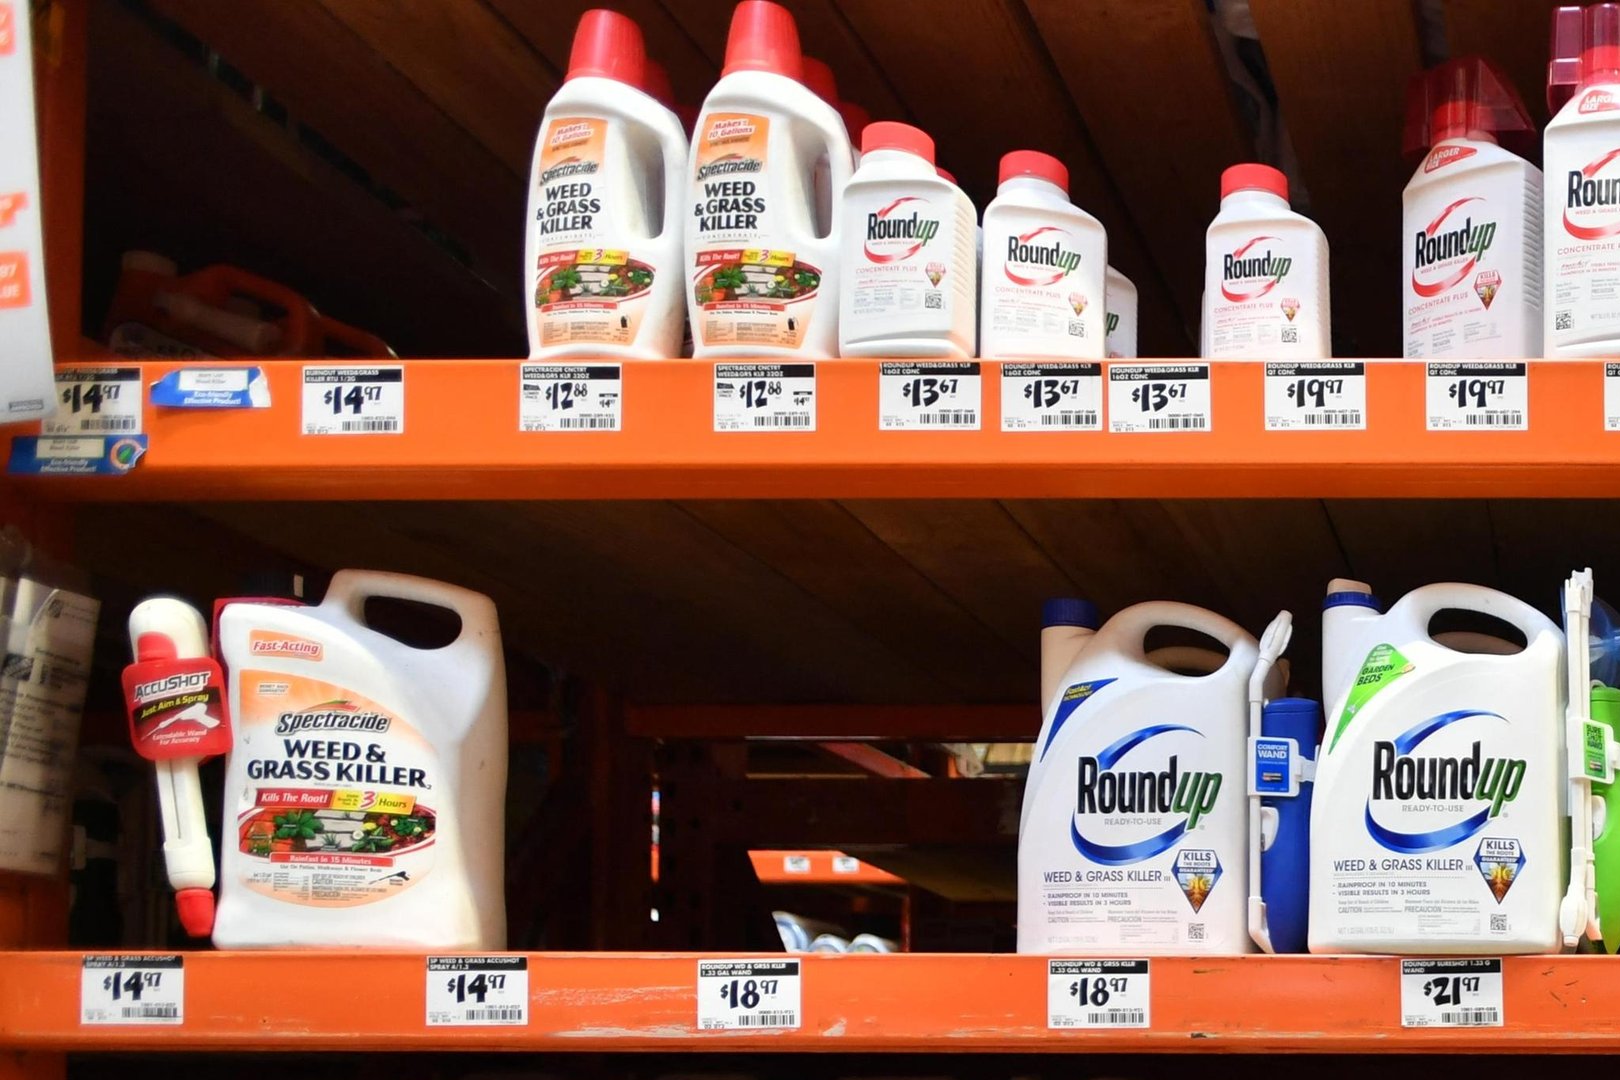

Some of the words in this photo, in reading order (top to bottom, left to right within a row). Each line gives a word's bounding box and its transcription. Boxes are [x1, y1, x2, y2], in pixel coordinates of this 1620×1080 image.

[697, 159, 762, 181] Spectracide
[546, 182, 592, 200] WEED
[704, 181, 756, 199] WEED
[536, 207, 545, 220] &
[546, 199, 601, 217] GRASS
[695, 203, 704, 217] &
[706, 198, 766, 214] GRASS
[540, 216, 593, 235] KILLER
[699, 213, 758, 232] KILLER
[867, 212, 939, 247] Roundup
[1415, 217, 1497, 269] Roundup
[1008, 236, 1081, 276] Roundup
[1223, 250, 1292, 283] Roundup
[253, 640, 320, 655] Fast-Acting
[275, 711, 392, 735] Spectracide
[284, 739, 362, 761] WEED
[365, 741, 386, 762] &
[1257, 750, 1288, 759] WAND
[247, 760, 329, 782] GRASS
[1373, 741, 1527, 818] Roundup
[1078, 755, 1222, 831] Roundup
[1402, 804, 1464, 813] READY-TO-USE
[1486, 840, 1515, 851] KILLS
[1334, 860, 1365, 872] WEED
[1368, 860, 1378, 872] &
[1381, 860, 1423, 872] GRASS
[1426, 859, 1464, 871] KILLER
